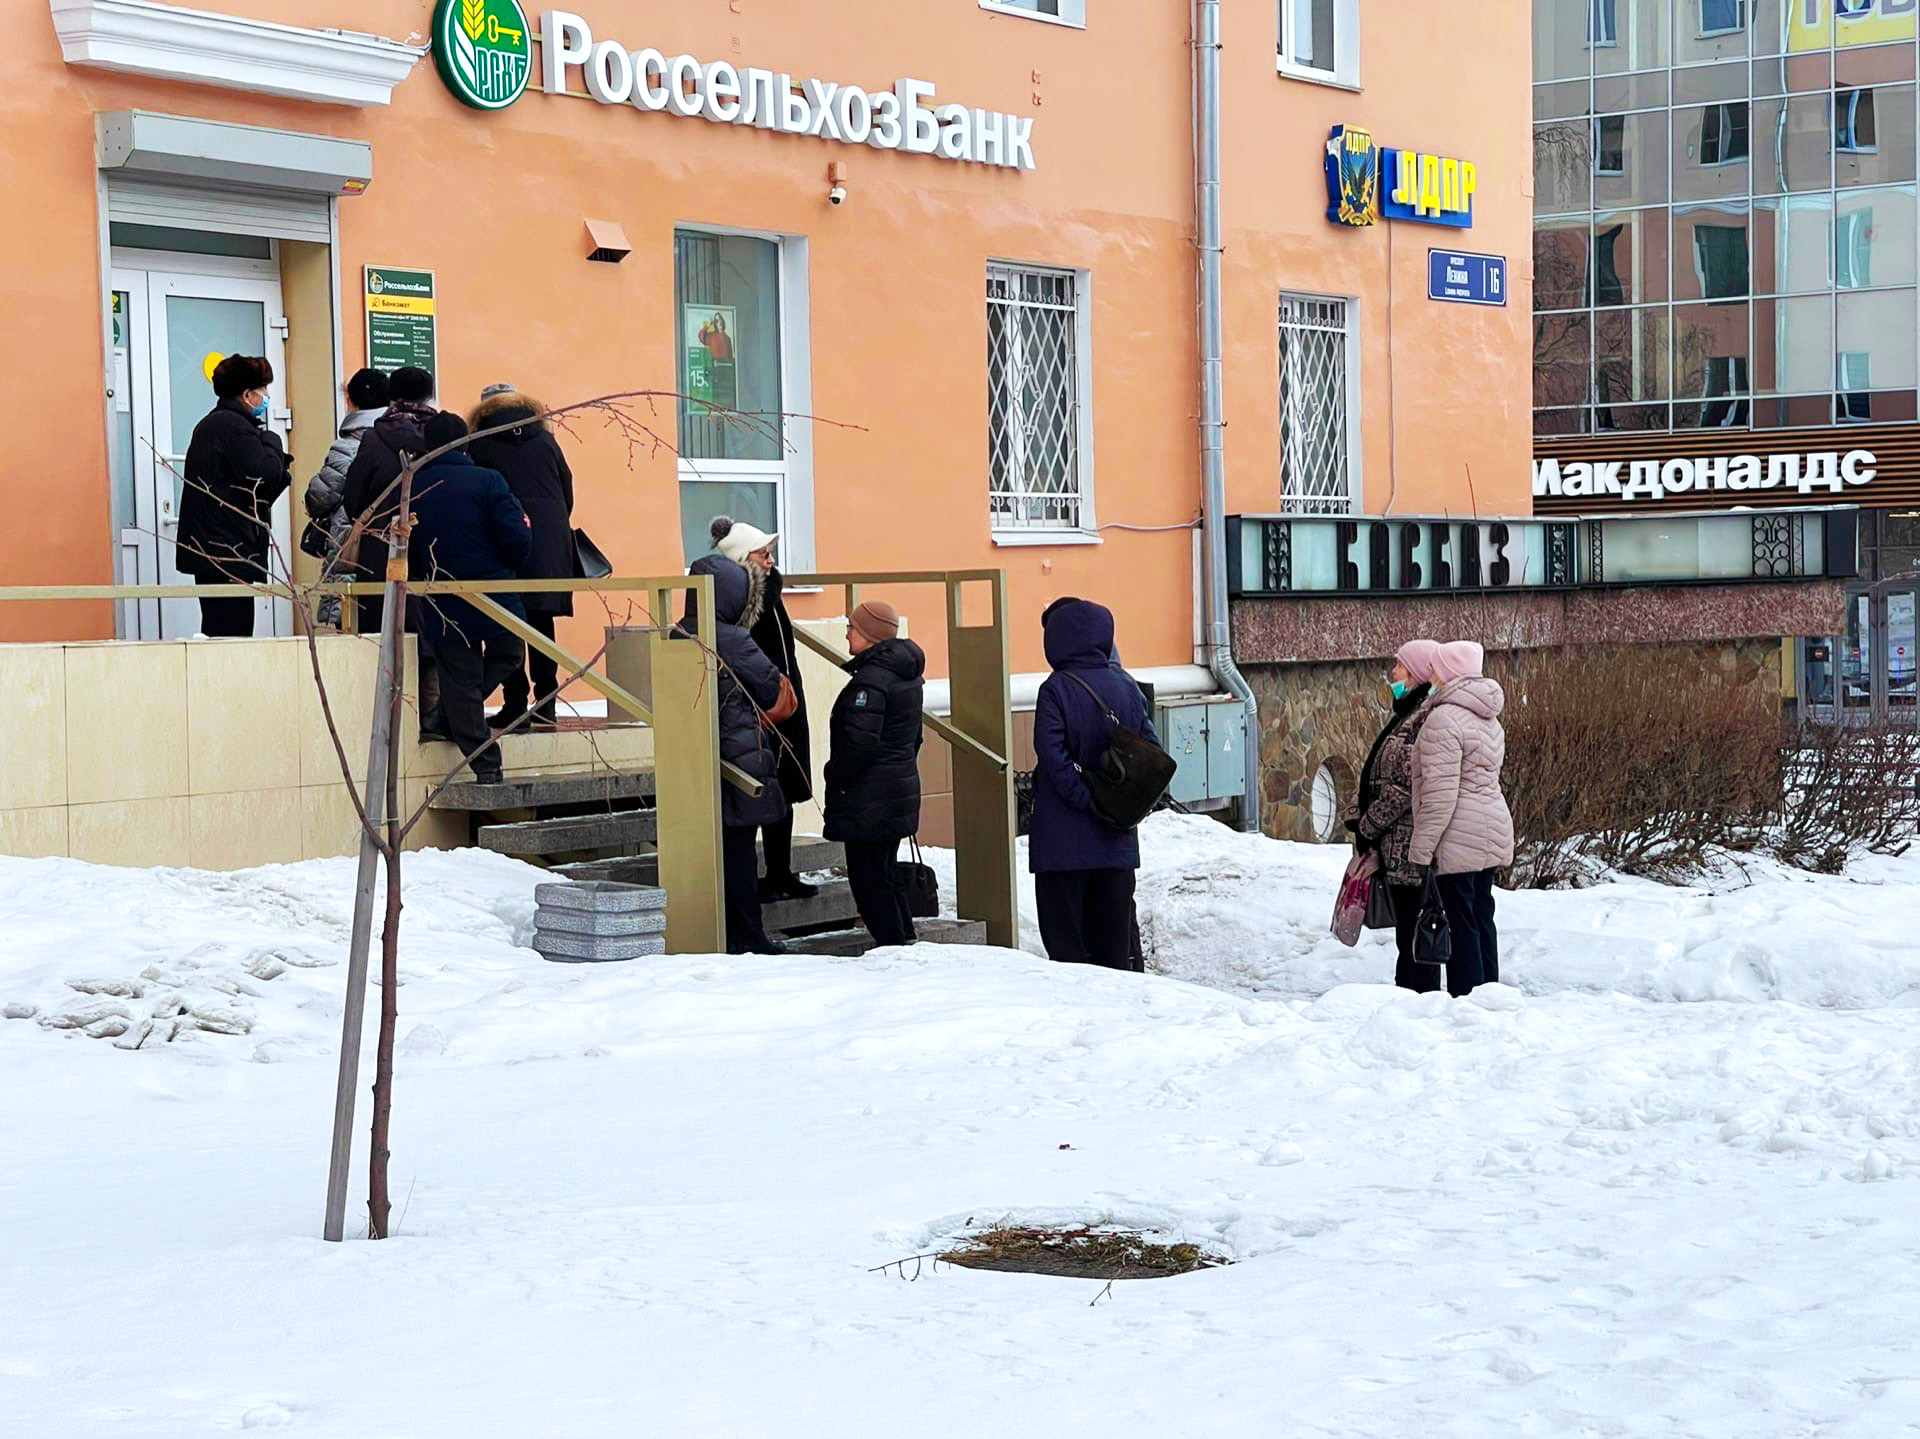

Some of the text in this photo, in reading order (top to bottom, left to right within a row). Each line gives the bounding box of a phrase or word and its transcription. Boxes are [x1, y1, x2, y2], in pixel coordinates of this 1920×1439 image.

[541, 10, 1035, 170] РоссельхозБанк
[1392, 150, 1476, 217] ЛДПР
[1490, 267, 1500, 294] 16
